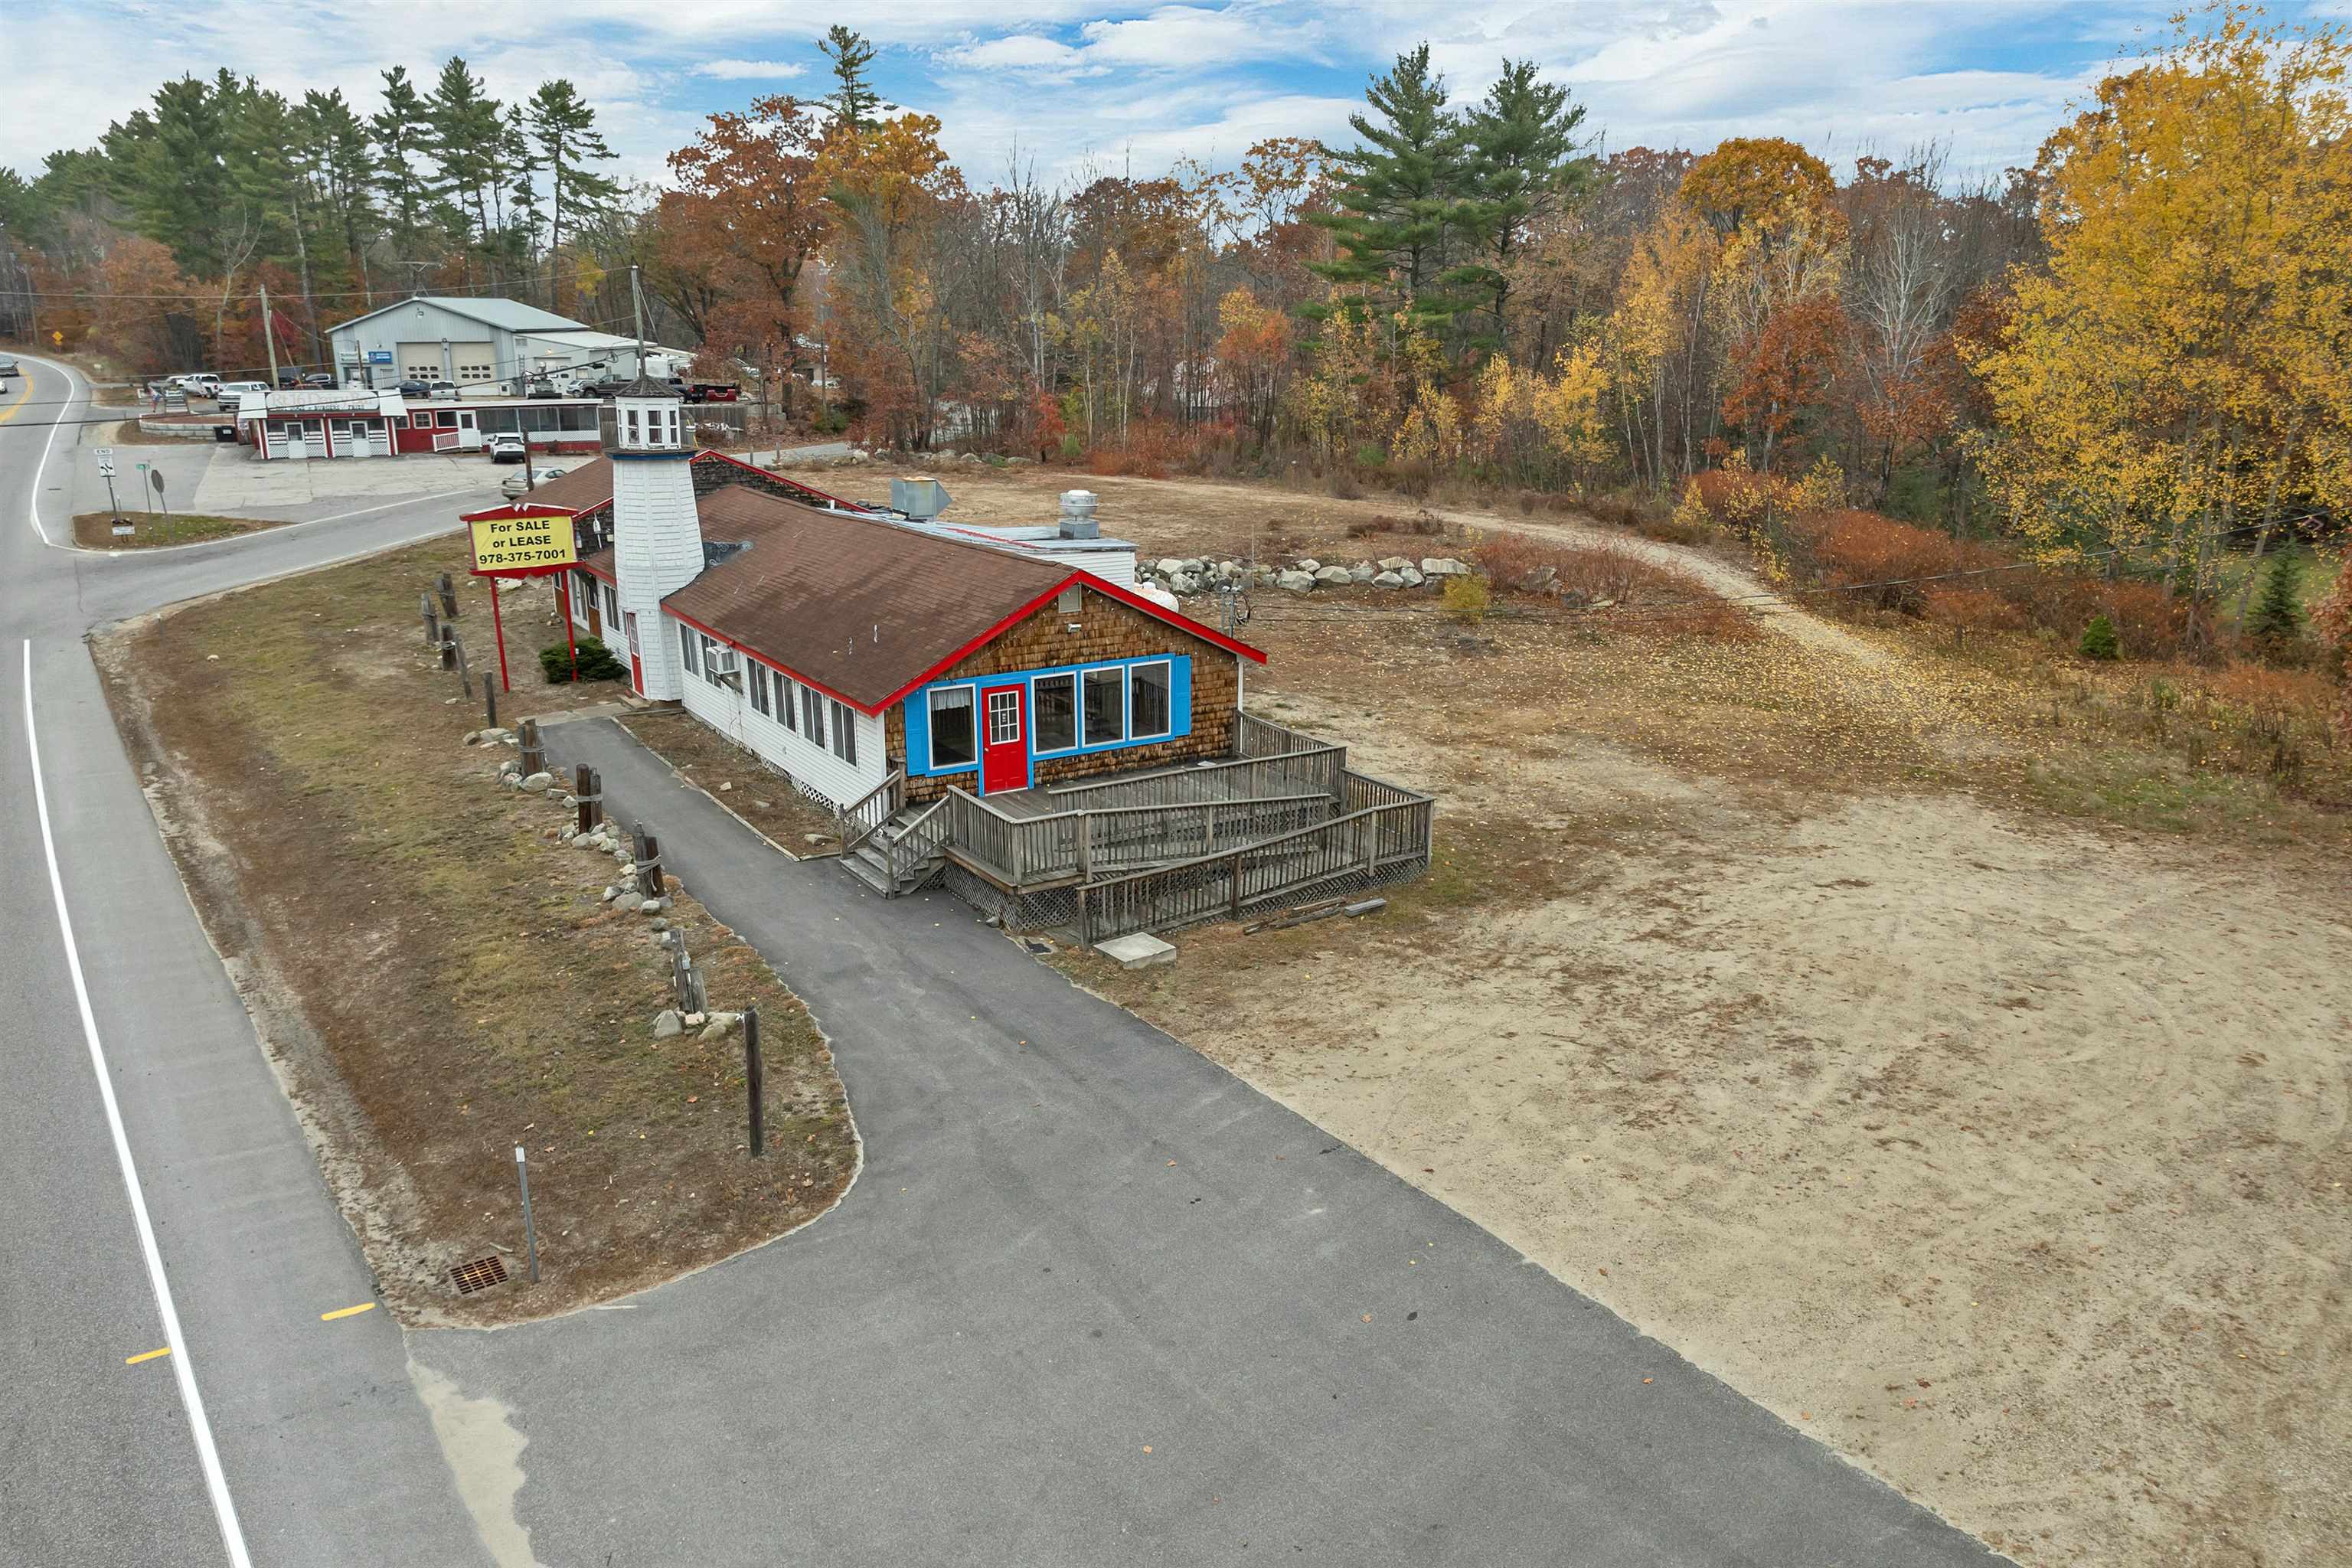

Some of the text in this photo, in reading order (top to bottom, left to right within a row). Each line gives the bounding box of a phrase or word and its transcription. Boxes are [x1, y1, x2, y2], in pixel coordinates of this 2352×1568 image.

[491, 521, 550, 533] For SALE
[493, 535, 551, 548] or LEASE
[479, 549, 565, 564] 978-375-7001
